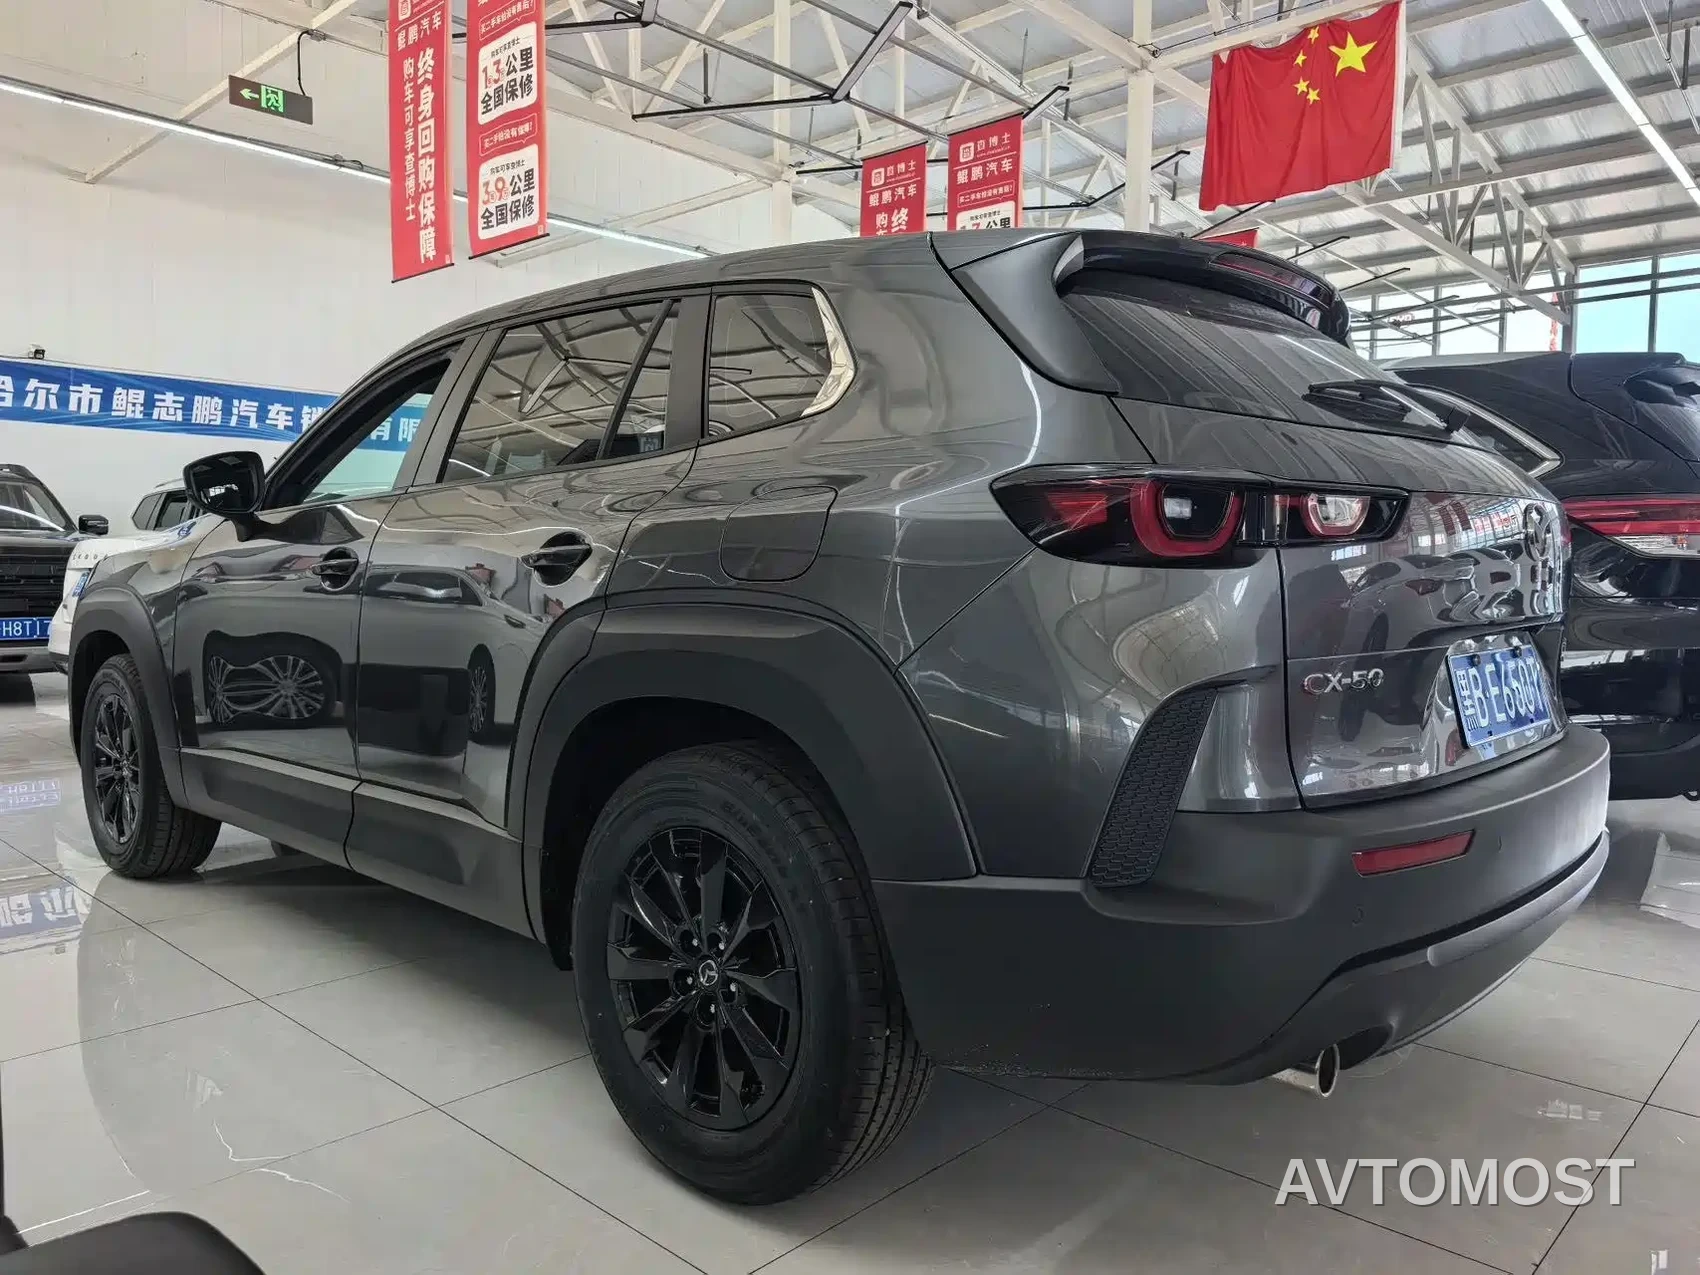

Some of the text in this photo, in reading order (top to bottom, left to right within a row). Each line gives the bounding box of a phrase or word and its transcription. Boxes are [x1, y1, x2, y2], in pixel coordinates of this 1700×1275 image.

[480, 73, 534, 115] 全国保修
[402, 57, 416, 221] 购车可享查博士
[417, 47, 437, 264] 终身回购保障
[956, 157, 1013, 185] 鲲鹏汽车
[868, 183, 918, 207] 鲲鹏汽车
[480, 193, 536, 230] 全国保修
[890, 206, 909, 233] 终
[1304, 668, 1385, 695] CX-50
